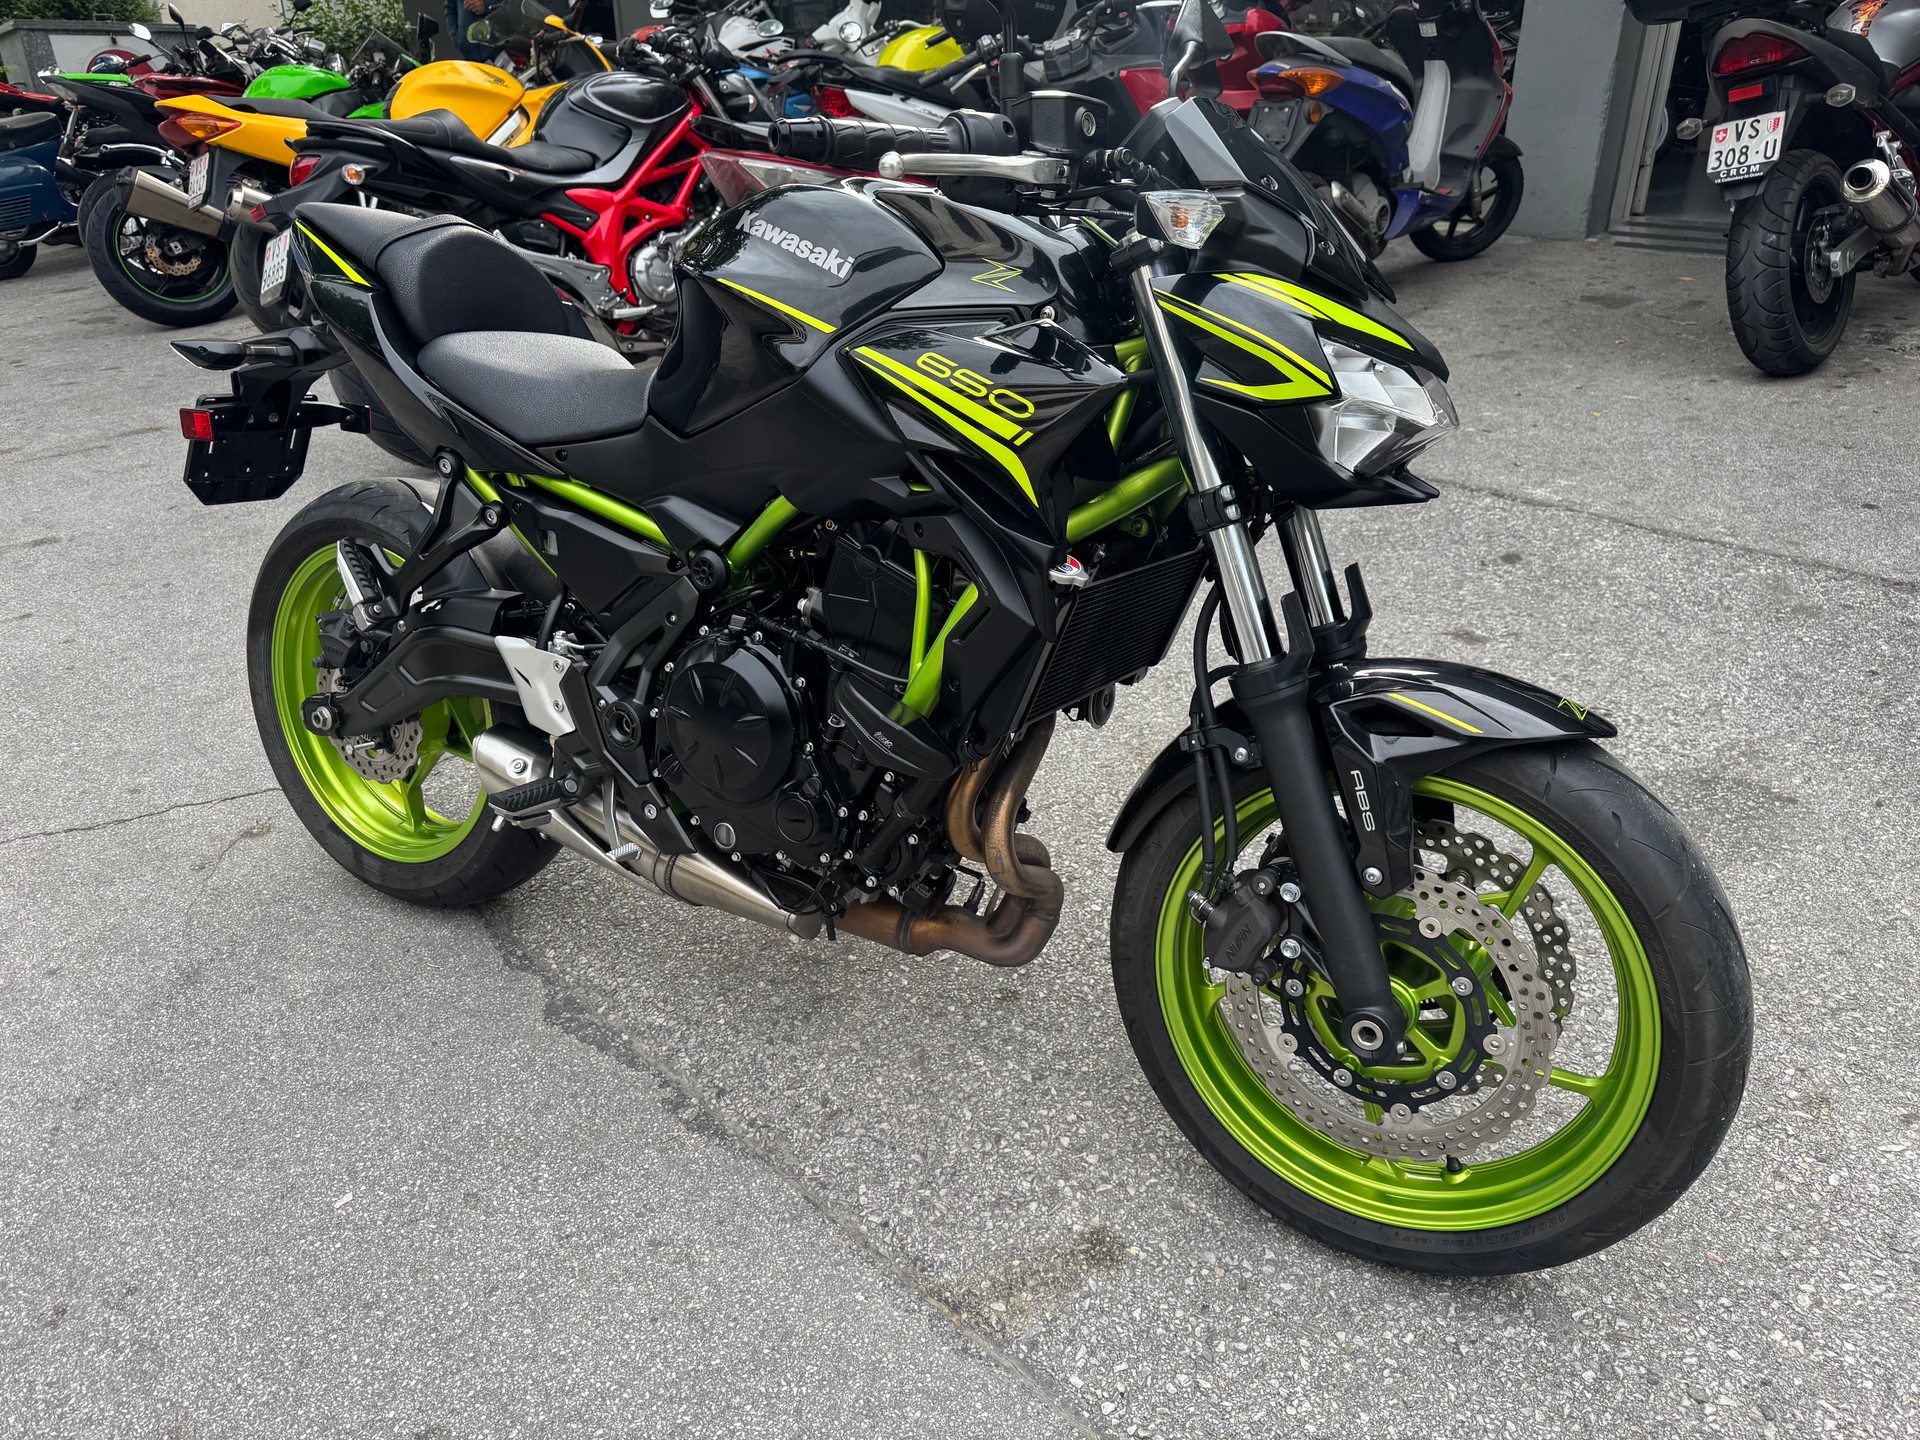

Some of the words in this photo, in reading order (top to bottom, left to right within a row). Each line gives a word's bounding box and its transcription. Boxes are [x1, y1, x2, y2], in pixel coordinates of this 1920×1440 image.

[1735, 119, 1761, 143] VS
[1720, 164, 1760, 178] CROM
[272, 235, 282, 261] VS
[735, 209, 855, 279] Kawasaki
[262, 258, 286, 291] 96885
[916, 351, 1036, 419] 650
[1350, 769, 1376, 832] ABS
